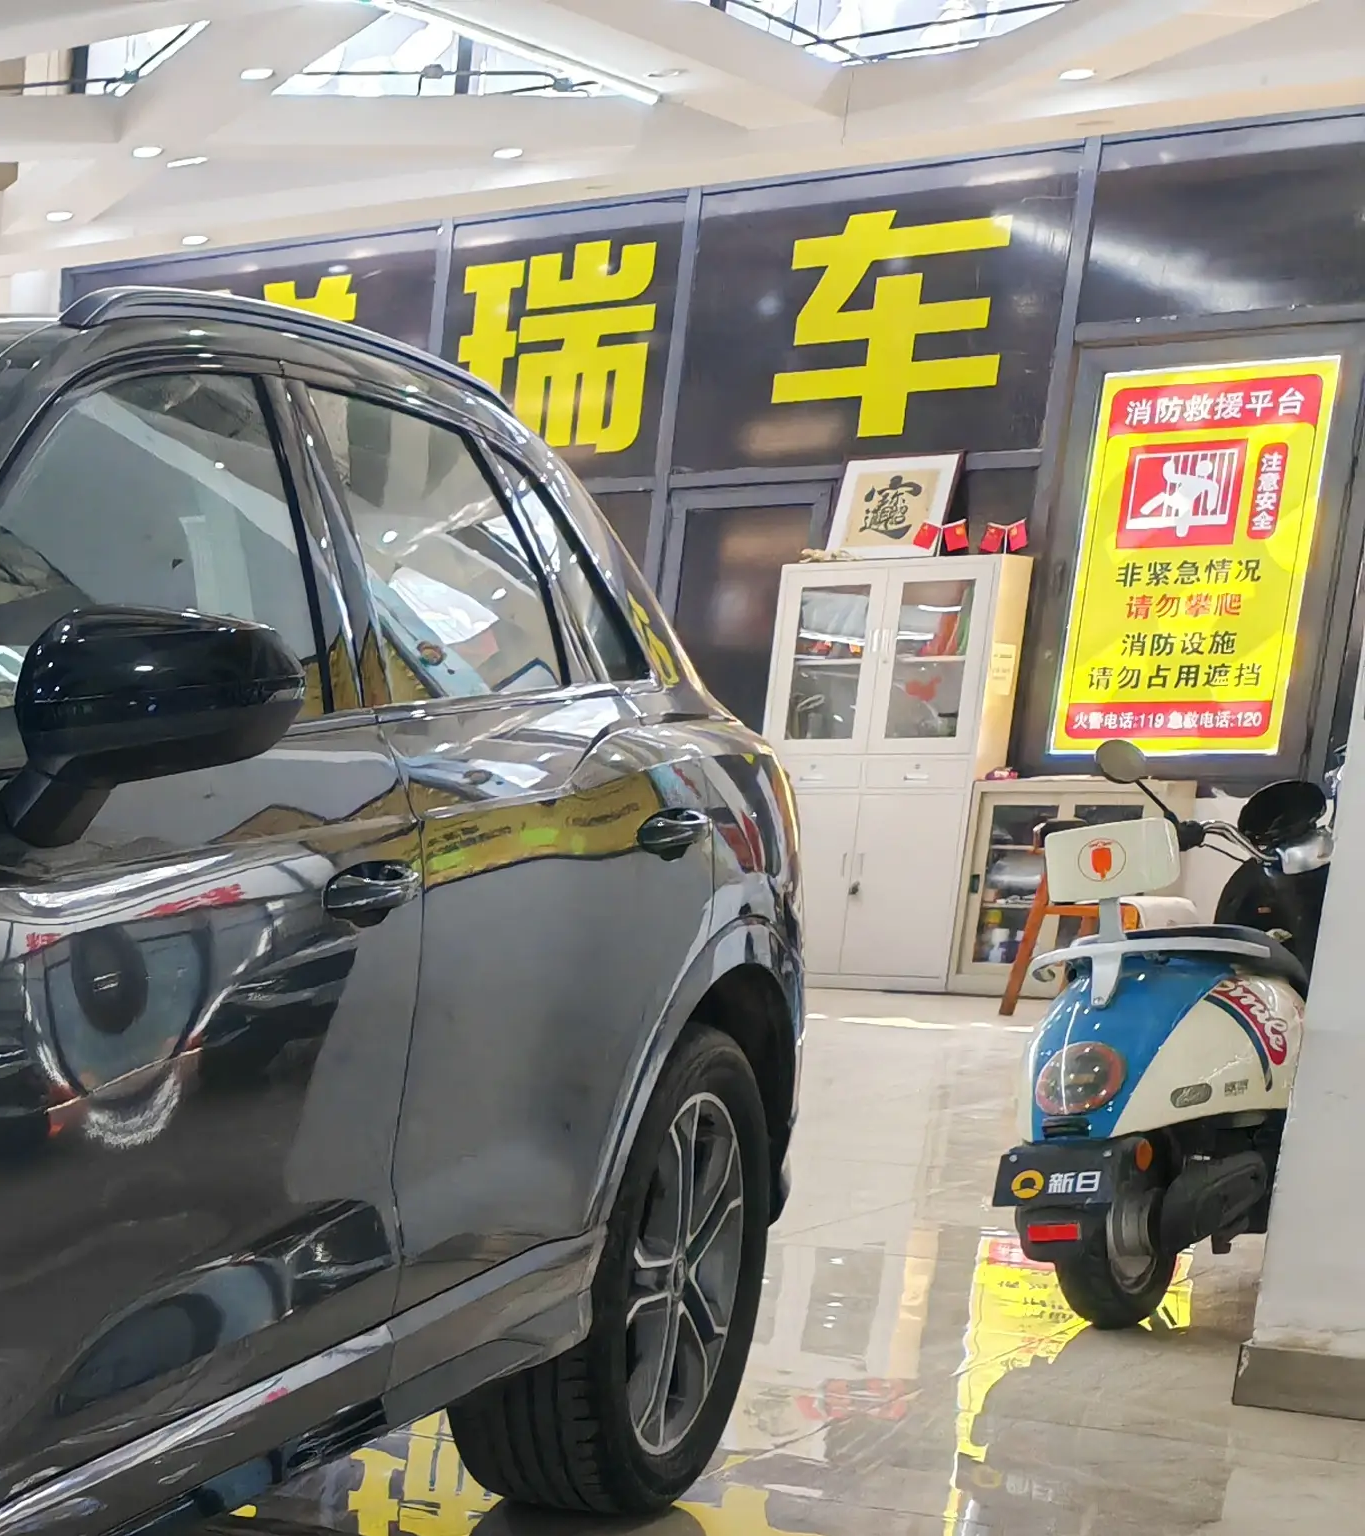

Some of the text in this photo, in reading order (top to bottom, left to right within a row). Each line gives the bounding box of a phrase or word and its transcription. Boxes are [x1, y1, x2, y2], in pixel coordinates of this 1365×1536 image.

[263, 209, 1013, 454] 瑞车
[1124, 387, 1306, 427] 消防救援平台
[1251, 451, 1284, 531] 注意安全
[1115, 558, 1262, 588] 非紧急情况
[1125, 592, 1242, 620] 请勿攀爬
[1120, 630, 1238, 658] 消防设施
[1087, 662, 1263, 691] 请勿占用遮挡
[1072, 711, 1264, 730] 火警电话:119 急救电话:120
[1047, 1170, 1103, 1194] 新日
